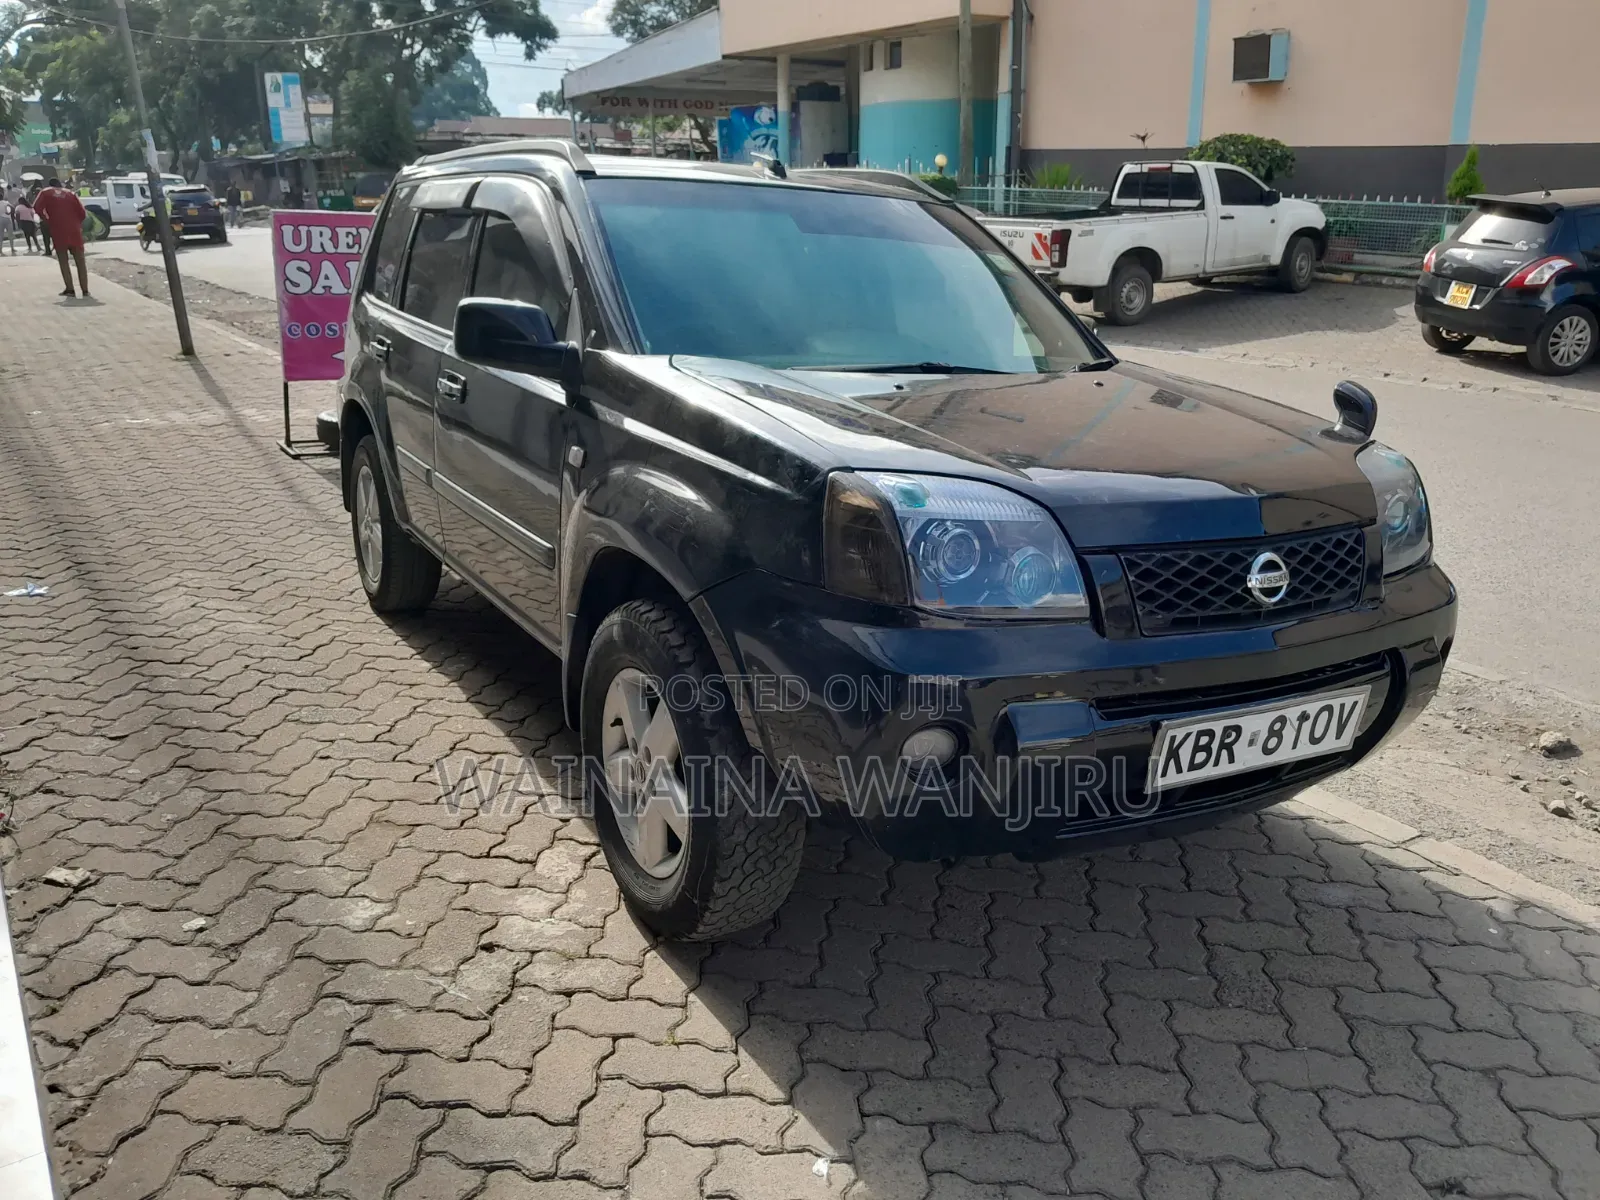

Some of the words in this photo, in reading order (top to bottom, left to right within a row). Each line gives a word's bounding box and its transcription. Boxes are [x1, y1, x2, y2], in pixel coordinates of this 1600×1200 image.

[600, 96, 632, 107] FOR
[683, 100, 714, 110] GOD
[1000, 230, 1024, 238] ISUZU
[286, 322, 347, 339] COS
[1255, 573, 1289, 585] NISSAN
[1160, 724, 1243, 778] KBR
[1261, 700, 1359, 756] 810V
